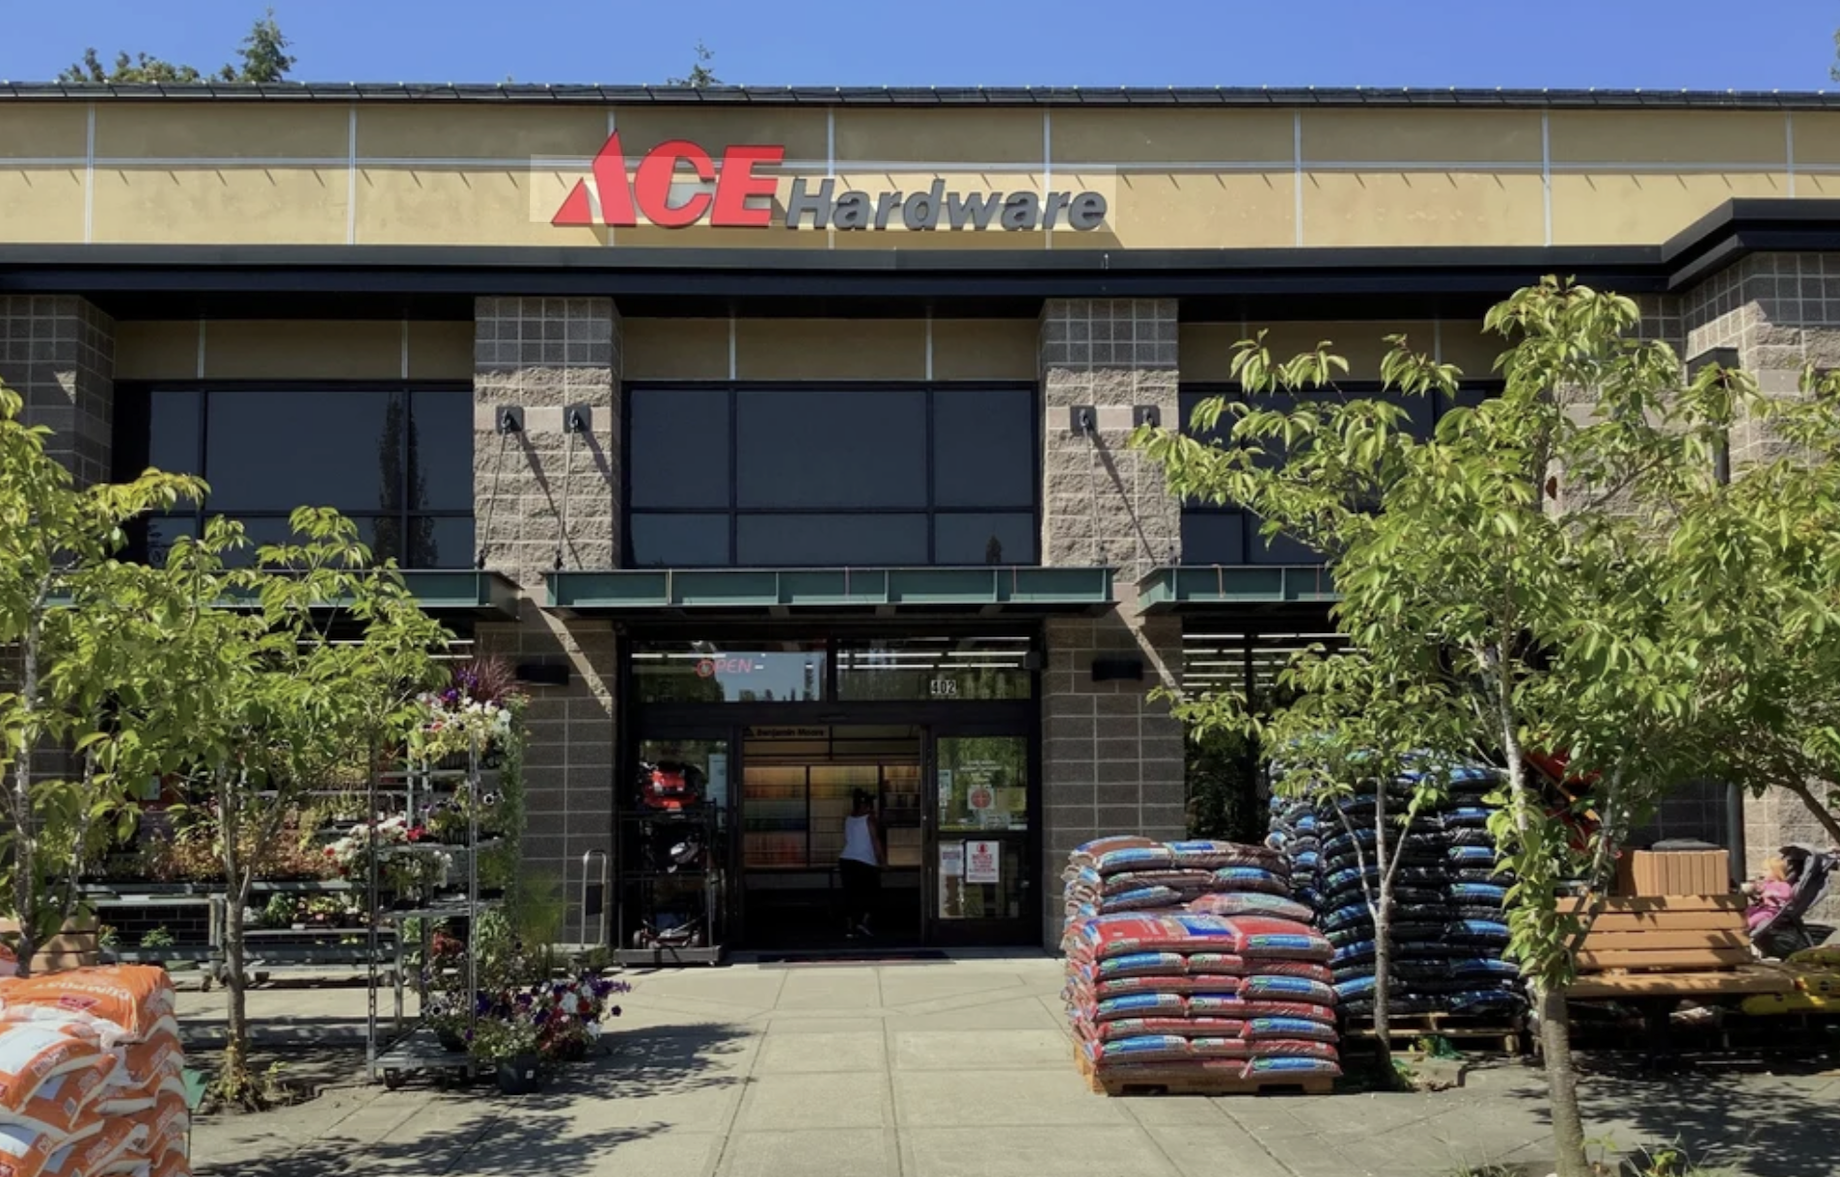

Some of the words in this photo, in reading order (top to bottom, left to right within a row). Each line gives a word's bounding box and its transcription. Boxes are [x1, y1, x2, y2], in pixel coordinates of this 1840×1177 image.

[551, 129, 785, 228] ACE
[786, 178, 1107, 231] Hardware
[696, 658, 752, 677] OPEN
[931, 681, 955, 694] 402
